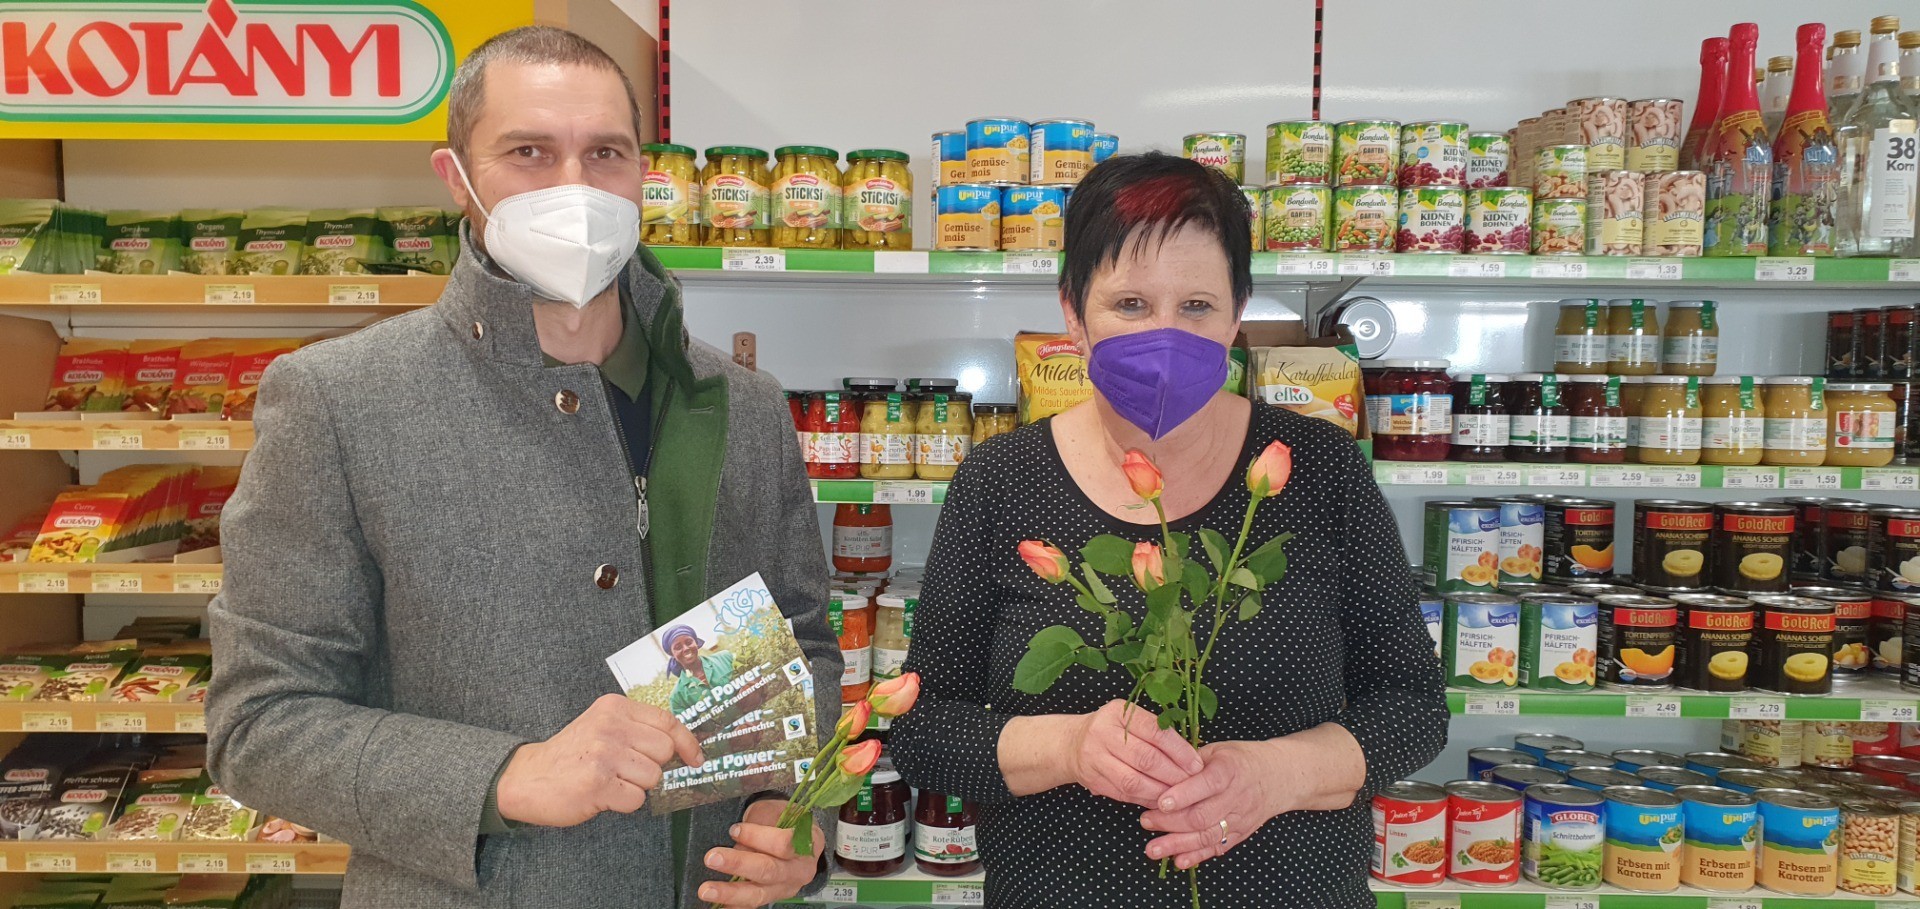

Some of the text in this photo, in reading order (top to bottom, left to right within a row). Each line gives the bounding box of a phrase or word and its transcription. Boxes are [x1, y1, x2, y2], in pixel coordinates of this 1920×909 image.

[1359, 132, 1390, 143] Bonduelle
[1886, 136, 1916, 160] 38
[971, 158, 1009, 168] Gemüse-
[1471, 159, 1503, 168] KIDNEY
[1886, 160, 1915, 171] Korn
[971, 168, 991, 177] mais
[1055, 170, 1078, 179] mais
[1286, 197, 1319, 206] Bonduelle
[1355, 199, 1387, 208] Bonduelle
[1420, 213, 1455, 221] KIDNEY
[1483, 213, 1519, 221] KIDNEY
[120, 225, 150, 235] Oregano
[196, 223, 225, 232] Oregano
[324, 222, 354, 230] Thymian
[945, 223, 983, 233] Gemüse-
[255, 228, 286, 236] Thymian
[318, 235, 352, 247] KOTÁNYI
[944, 232, 965, 242] mais
[1276, 361, 1358, 386] Kartoffelsalat
[1033, 387, 1094, 396] Mildes Sauerkra
[1274, 387, 1309, 402] efko
[74, 503, 96, 512] Curry
[1451, 537, 1485, 545] PFIRSICH-
[1732, 535, 1761, 543] ANANAS
[1451, 544, 1483, 553] HÄLFTEN
[1460, 632, 1496, 640] PFIRSICH-
[1544, 633, 1580, 641] PFIRSICH-
[1700, 632, 1730, 640] ANANAS
[1776, 634, 1807, 642] ANANAS
[1459, 641, 1493, 649] HÄLFTEN
[1544, 641, 1578, 649] HÄLFTEN
[685, 672, 777, 732] Rosen für Frauenrechte
[717, 721, 775, 741] Frauenrechte
[63, 775, 121, 785] Pfeffer schwarz
[663, 761, 787, 791] faire Rosen für Frauenrechte
[65, 789, 104, 800] KOTÁNYI
[1554, 811, 1597, 823] GLOBUS
[1389, 829, 1408, 837] Linsen
[1454, 827, 1472, 835] Linsen
[1617, 857, 1670, 870] Erbsen mit
[1699, 858, 1736, 870] Erbsen
[1778, 860, 1832, 874] Erbsen mit
[1616, 866, 1662, 880] Karotten
[1699, 867, 1744, 879] Karotten
[1778, 870, 1825, 883] Karotten
